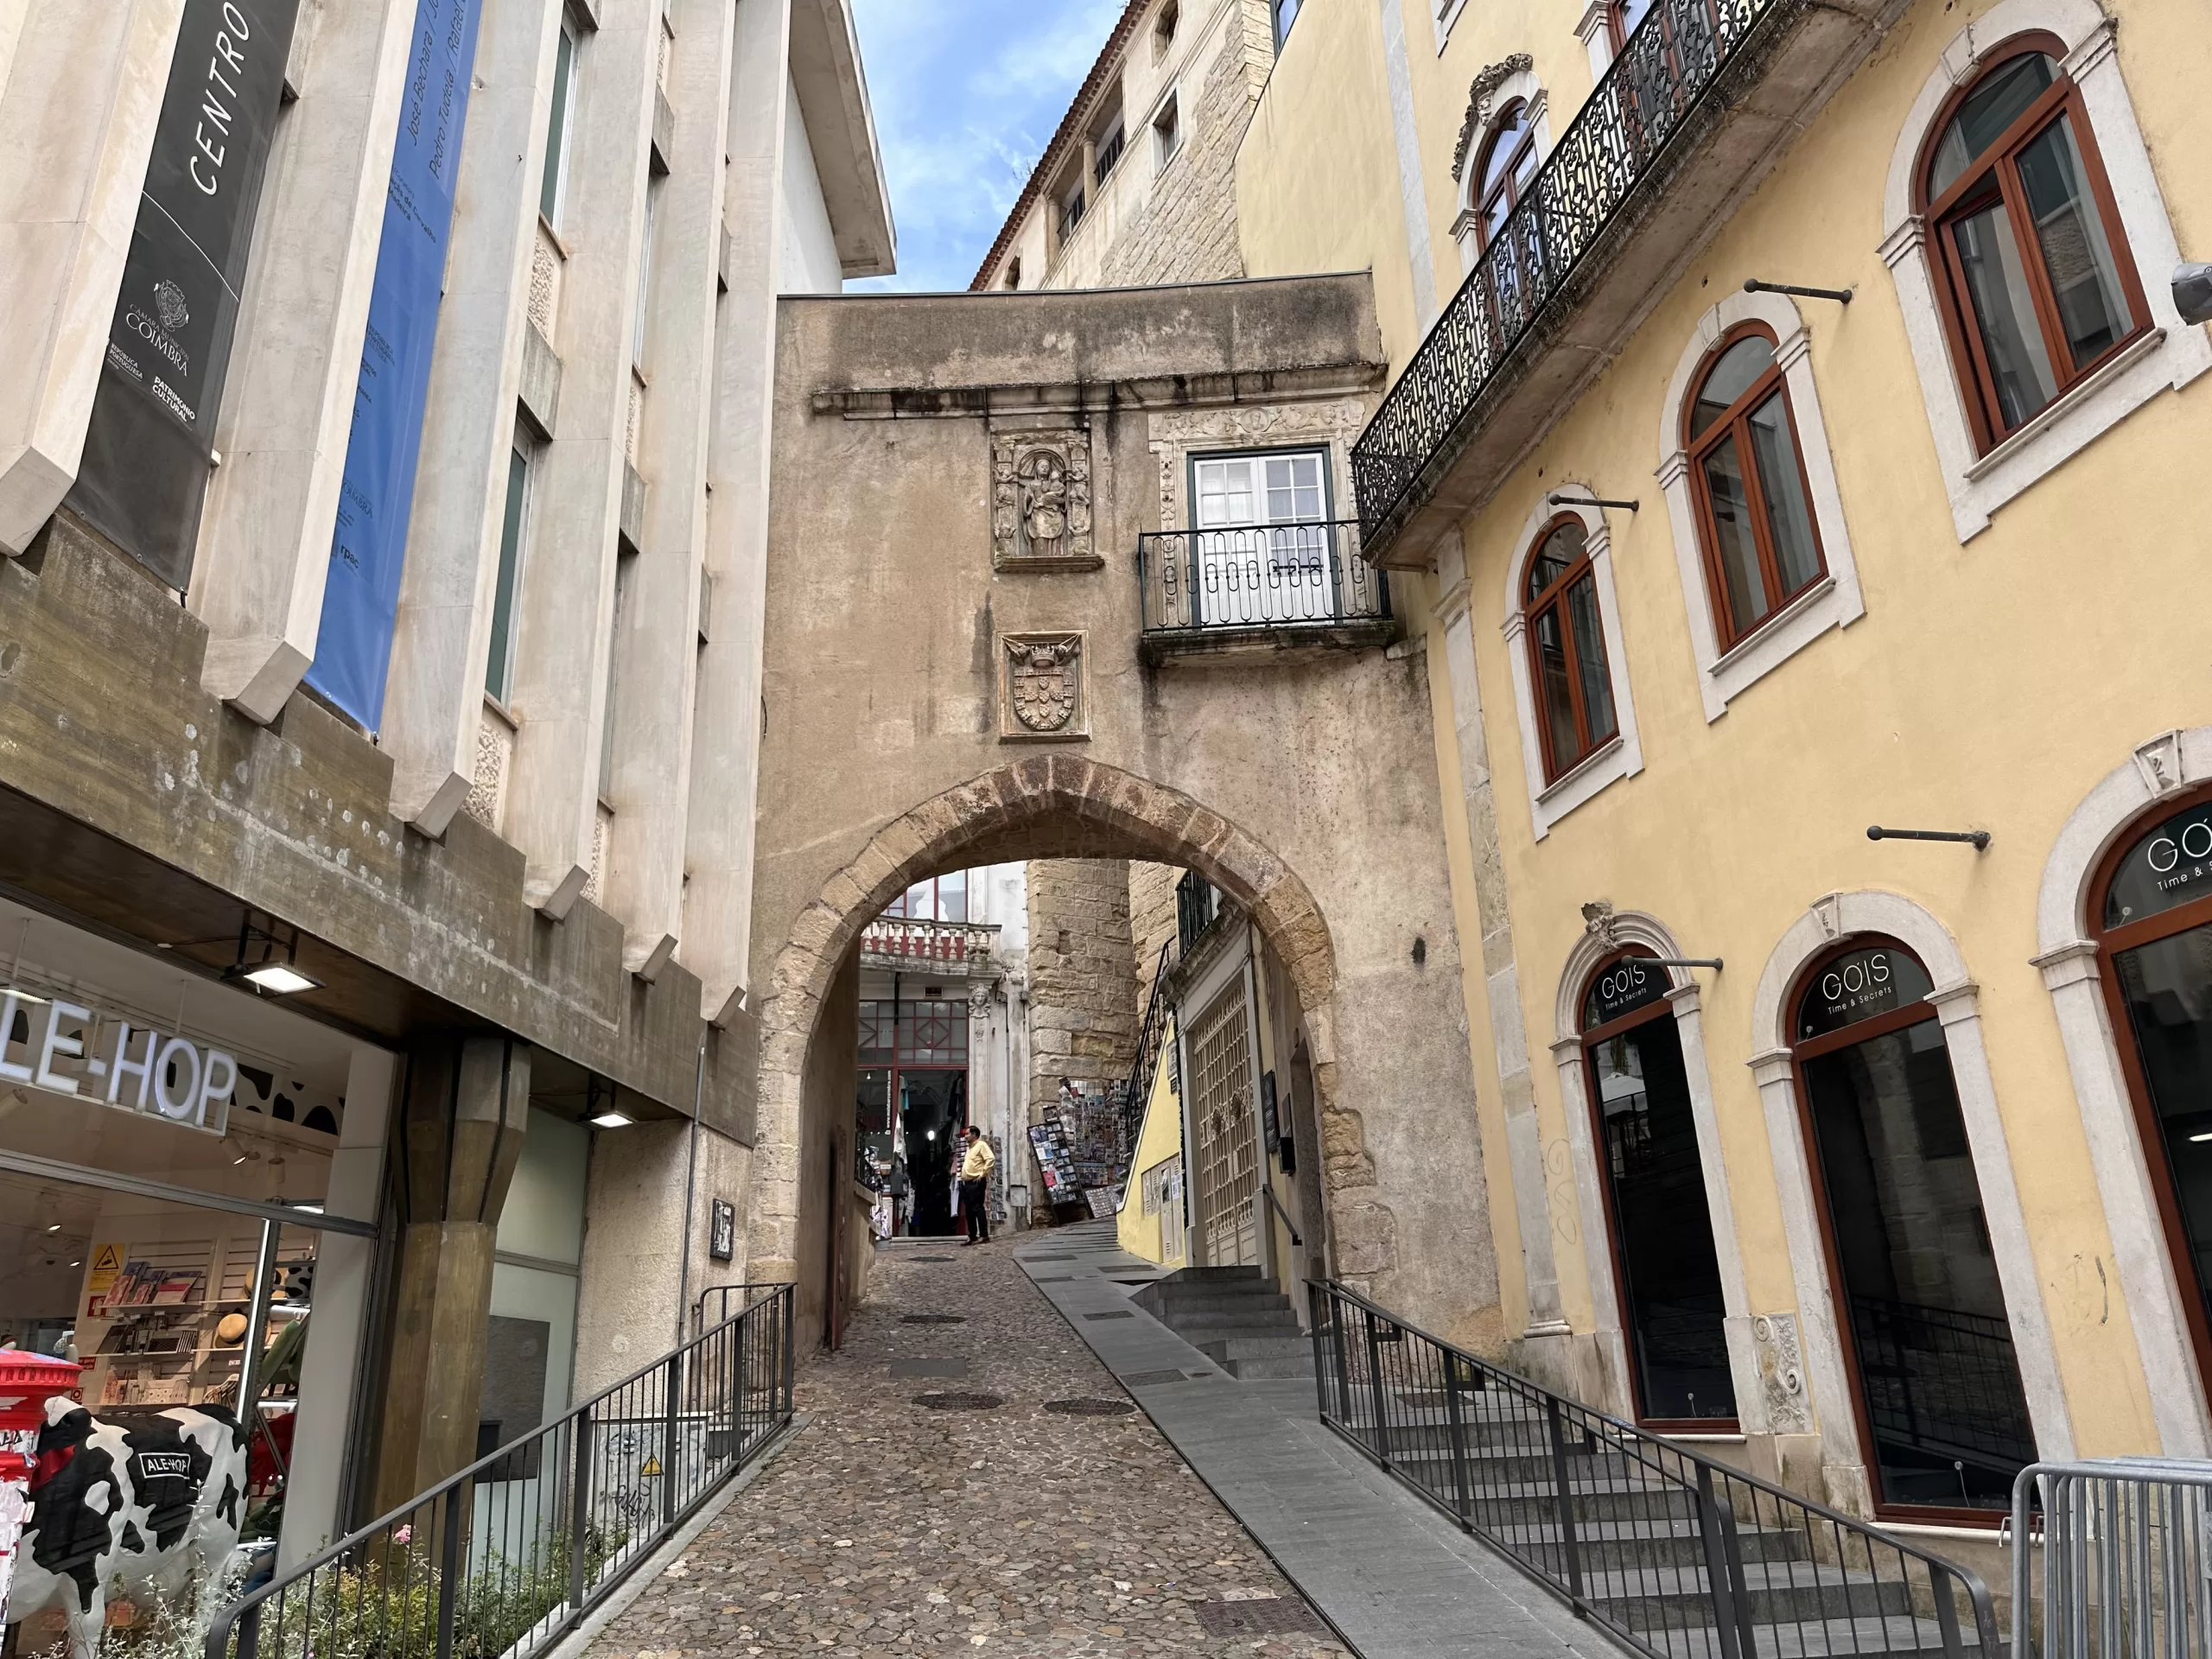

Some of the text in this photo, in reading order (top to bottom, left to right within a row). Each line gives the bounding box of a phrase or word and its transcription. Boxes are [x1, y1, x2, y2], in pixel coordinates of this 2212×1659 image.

[413, 30, 434, 102] Bechara
[189, 1, 250, 196] CENTRO
[429, 126, 446, 180] Pedro
[438, 68, 454, 124] Tudela
[448, 0, 464, 56] Rafael
[407, 99, 422, 146] José
[126, 313, 188, 377] COIMBRA
[109, 349, 143, 379] PORTUGUESA
[152, 385, 188, 422] CULTURAL
[342, 482, 373, 518] OIMBRA
[340, 544, 359, 569] rpac
[2157, 867, 2203, 891] Time &
[1605, 1001, 1618, 1011] Time
[1625, 987, 1647, 1001] Secrets
[1827, 986, 1892, 1014] Time & Secrets
[148, 1458, 188, 1472] ALE-HOP
